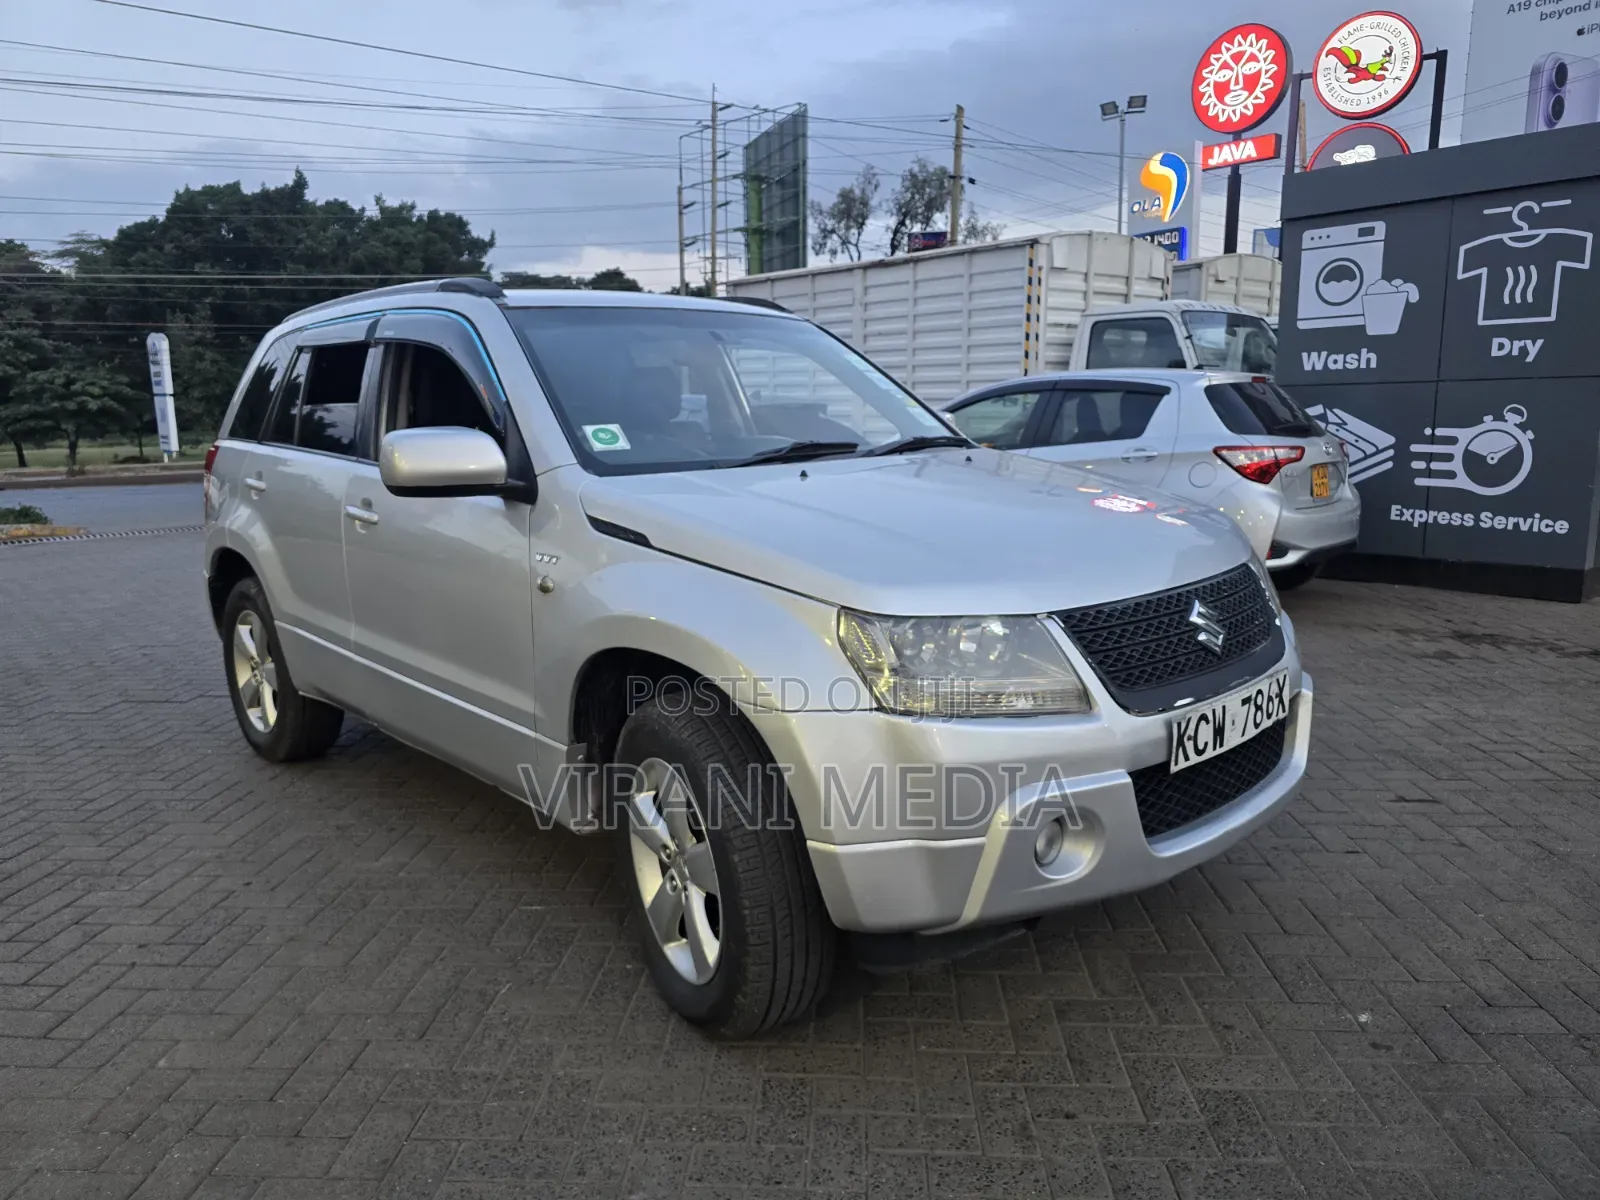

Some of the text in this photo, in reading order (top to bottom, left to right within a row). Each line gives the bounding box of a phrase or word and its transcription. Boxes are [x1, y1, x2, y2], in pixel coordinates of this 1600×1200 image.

[1506, 0, 1532, 15] A19
[1540, 0, 1592, 21] beyond
[1586, 22, 1600, 35] iP
[1337, 21, 1411, 72] FLAME-GRILLED CHICKEN
[1323, 66, 1389, 107] ESTABLISHED 1996
[1207, 140, 1258, 166] JAVA
[1301, 348, 1377, 371] Wash
[1490, 337, 1544, 362] Dry
[1390, 504, 1570, 535] Express Service
[1174, 673, 1287, 767] KCW 786X
